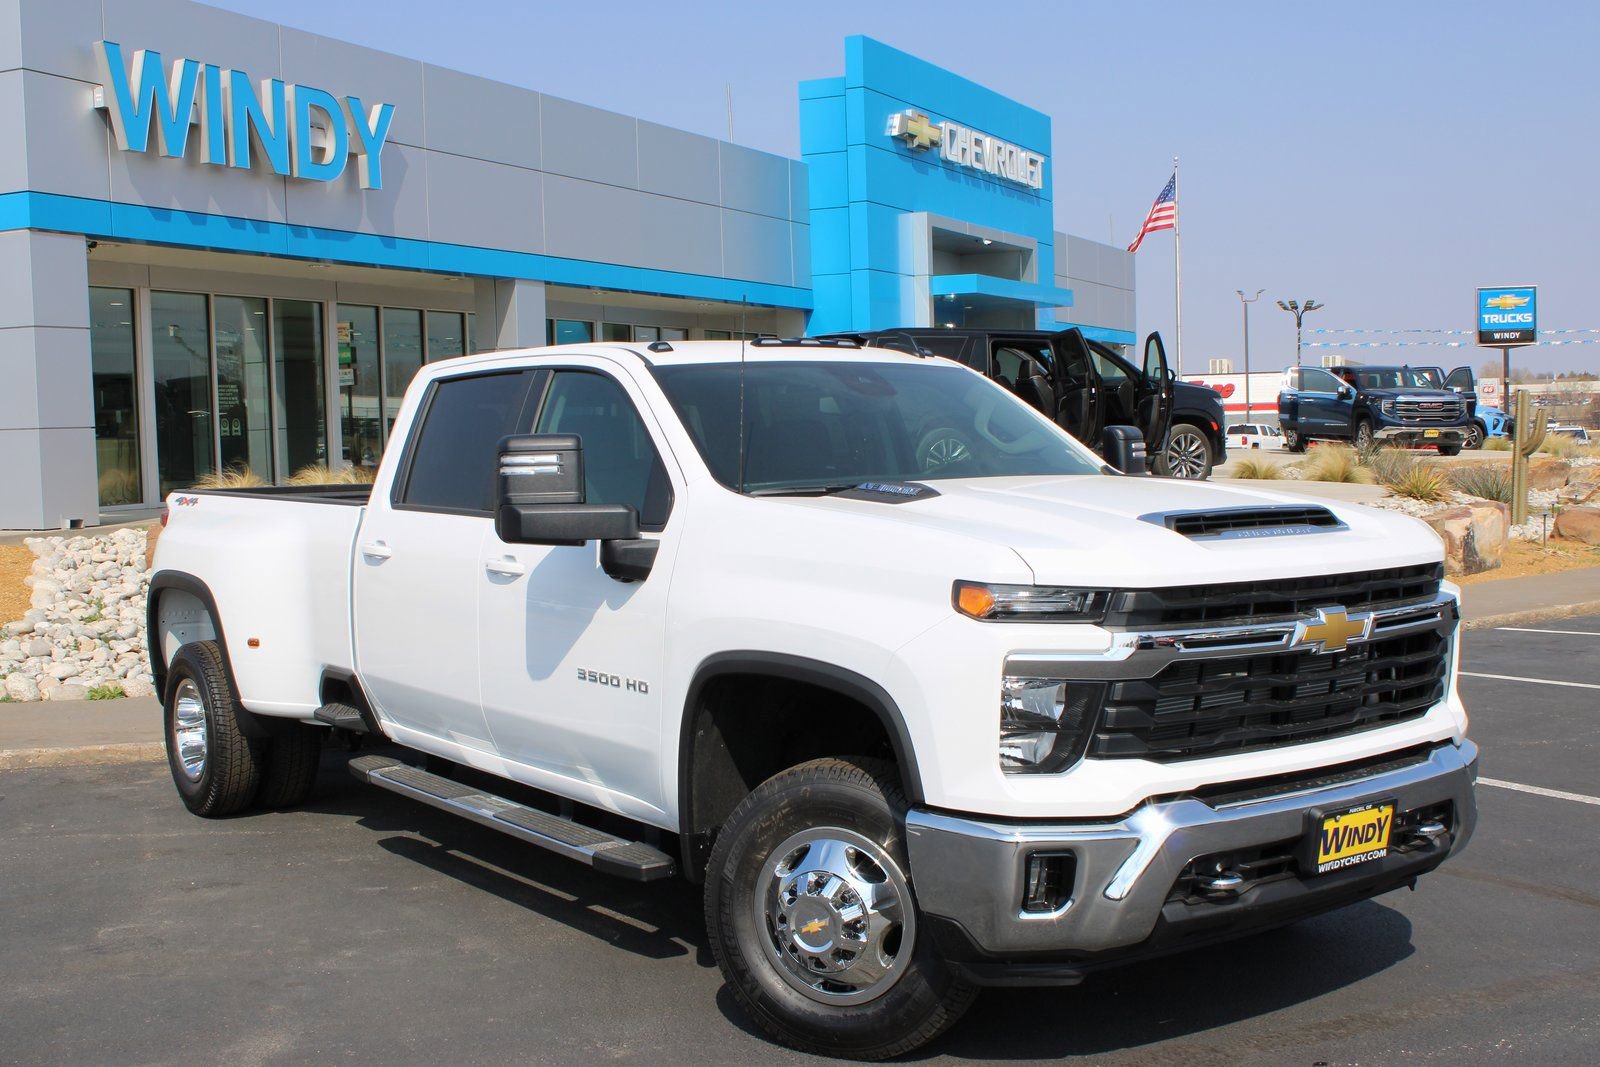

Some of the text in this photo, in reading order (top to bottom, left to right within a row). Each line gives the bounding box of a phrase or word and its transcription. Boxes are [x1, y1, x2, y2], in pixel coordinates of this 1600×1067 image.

[97, 41, 395, 190] WINDY
[938, 120, 1046, 190] CHEVROLET
[1482, 313, 1533, 324] TRUCKS
[1493, 332, 1521, 340] WINDY
[577, 667, 649, 694] 3500 HD
[1321, 814, 1390, 856] WINDY
[1318, 848, 1387, 873] WINDYCHEV.COM
